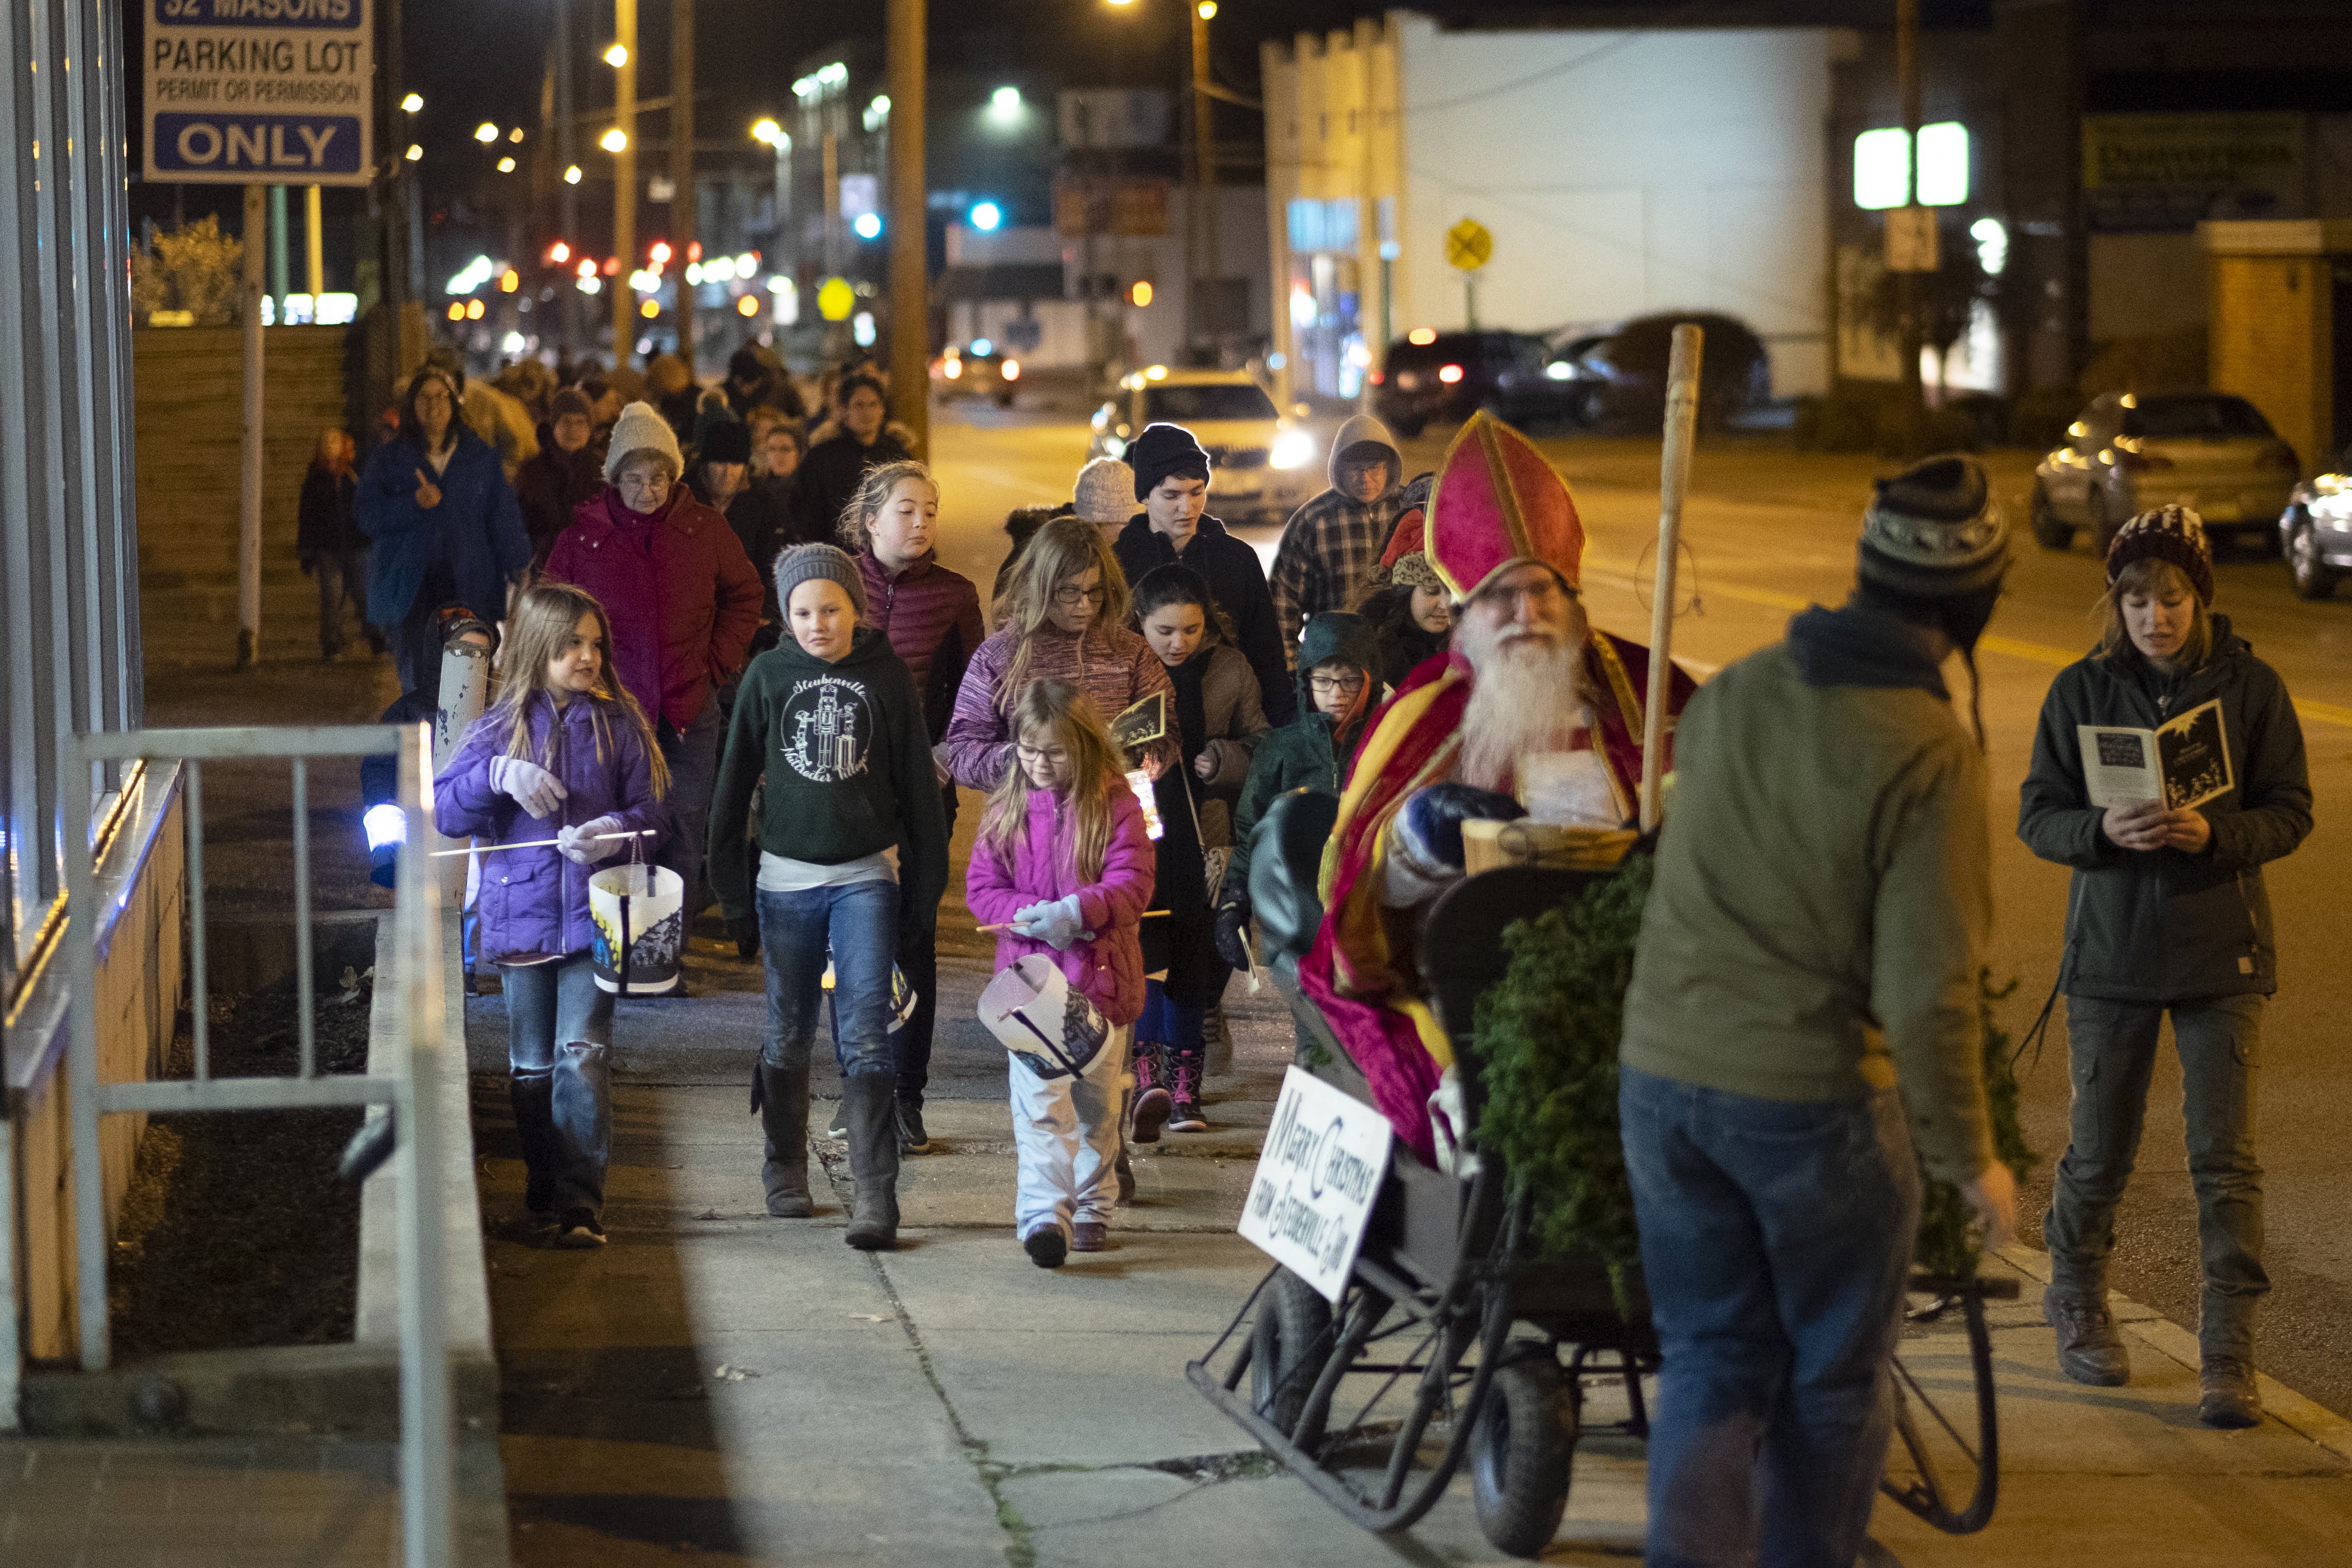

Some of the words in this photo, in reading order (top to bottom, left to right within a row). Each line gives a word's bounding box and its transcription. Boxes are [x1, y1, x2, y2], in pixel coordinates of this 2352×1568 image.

[213, 0, 351, 20] MASONS
[155, 39, 293, 72] PARKING
[304, 41, 361, 73] LOT
[156, 78, 219, 101] PERMIT
[225, 79, 251, 102] OR
[254, 79, 359, 104] PERMISSION
[178, 123, 337, 166] ONLY
[793, 673, 866, 697] Steubenville
[1311, 1116, 1374, 1206] CHRISTMAS
